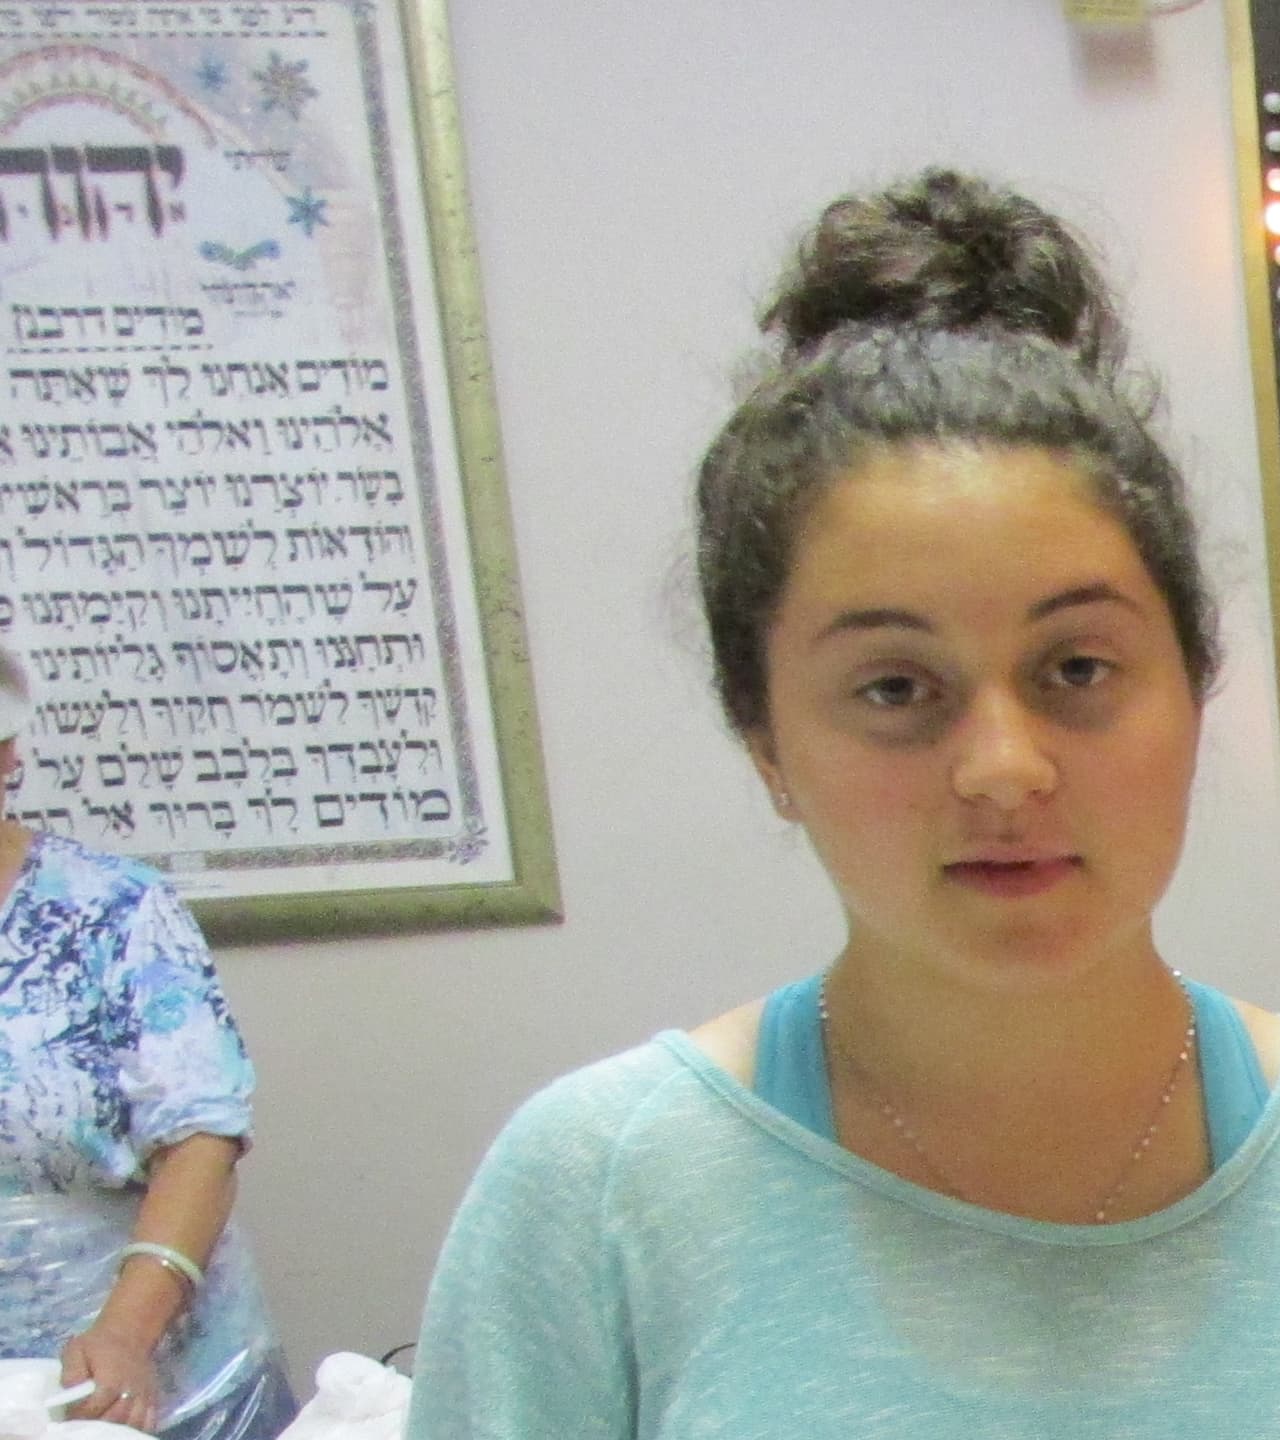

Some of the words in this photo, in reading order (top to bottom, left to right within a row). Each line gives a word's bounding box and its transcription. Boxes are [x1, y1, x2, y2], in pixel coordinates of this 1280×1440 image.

[113, 305, 204, 337] מודים
[296, 358, 388, 393] מודים
[314, 789, 451, 831] מודים
